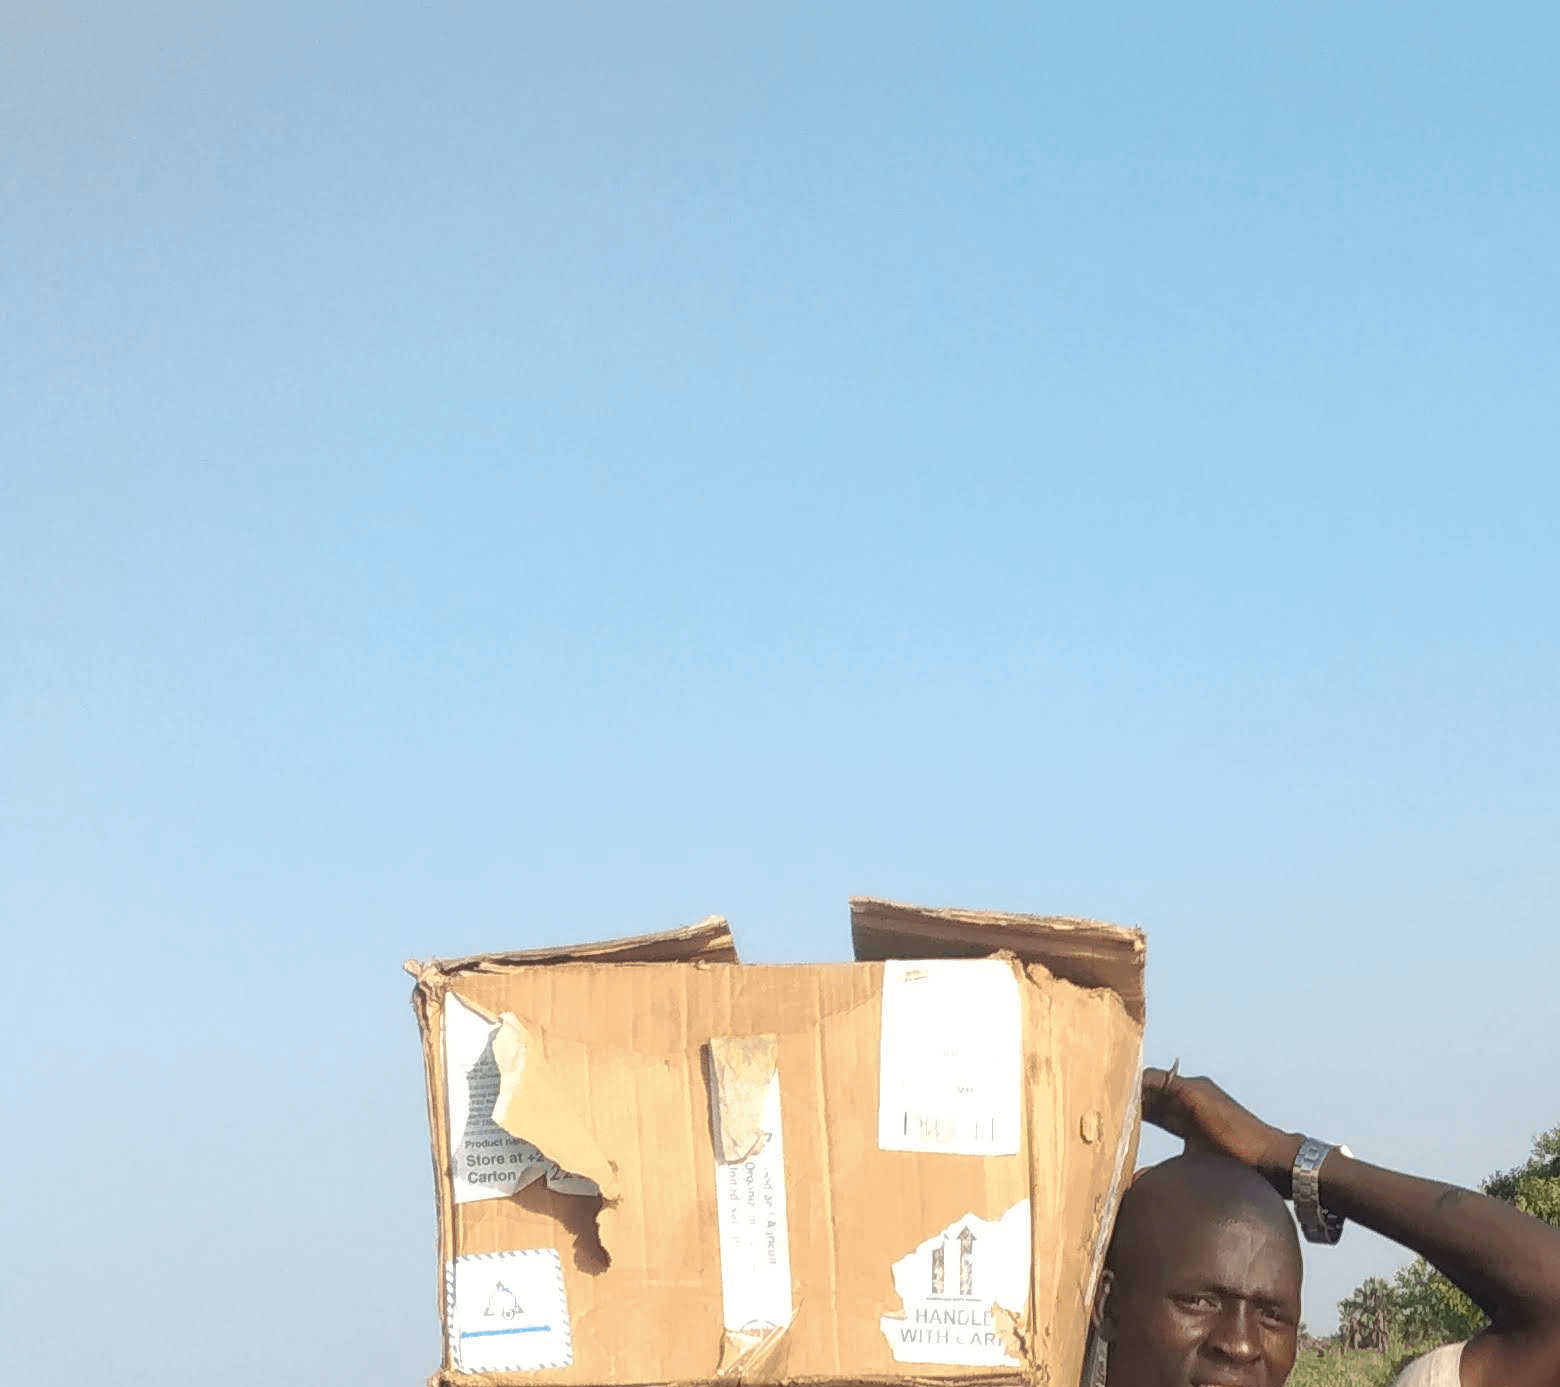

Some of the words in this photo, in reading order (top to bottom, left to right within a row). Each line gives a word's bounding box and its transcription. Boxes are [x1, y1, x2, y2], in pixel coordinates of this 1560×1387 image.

[465, 1138, 503, 1149] Product
[466, 1154, 505, 1167] Store
[509, 1152, 523, 1163] at
[468, 1170, 516, 1184] Carton
[900, 1328, 949, 1345] WITH
